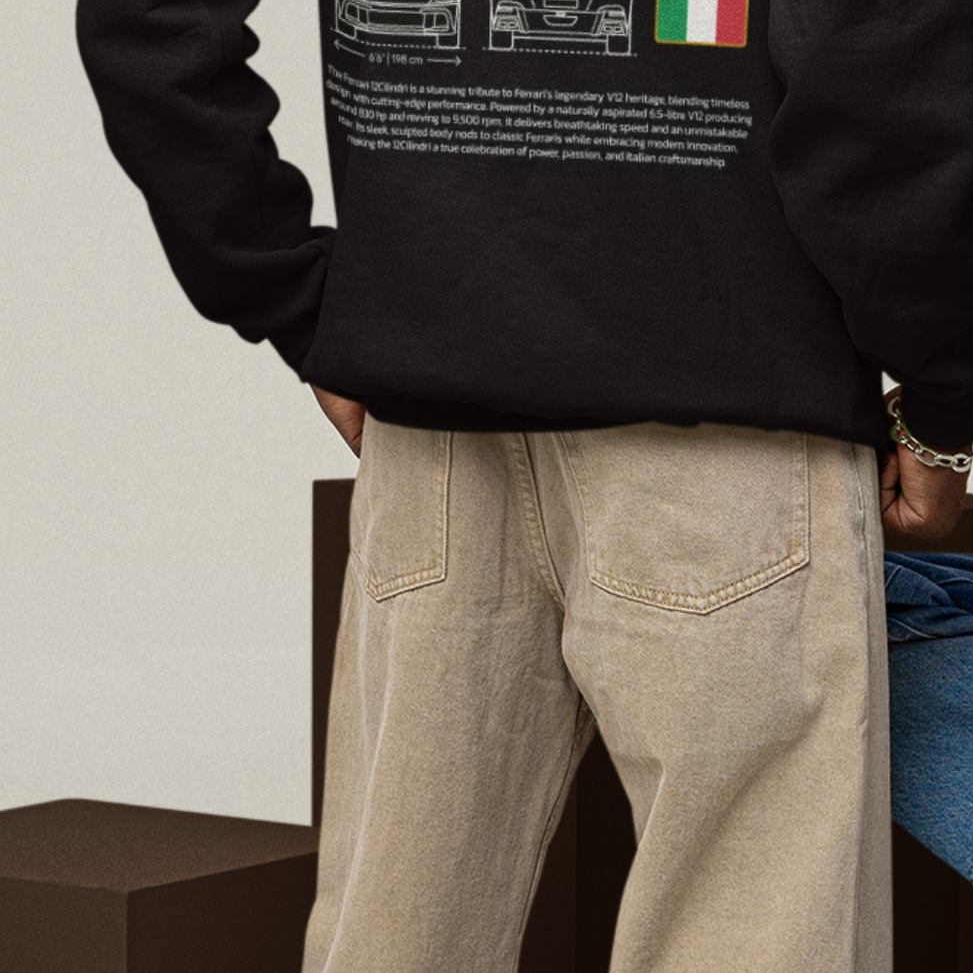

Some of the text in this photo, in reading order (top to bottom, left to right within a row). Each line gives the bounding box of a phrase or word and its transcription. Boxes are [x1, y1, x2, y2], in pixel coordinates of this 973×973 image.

[409, 56, 423, 65] cm
[410, 83, 417, 93] is
[426, 85, 466, 97] stunning
[468, 86, 500, 97] tribute
[502, 88, 512, 98] to
[554, 90, 604, 104] legendary
[607, 92, 624, 102] V12
[668, 95, 710, 109] blending
[711, 98, 750, 109] timeless
[388, 112, 405, 122] and
[441, 114, 450, 123] to
[514, 118, 552, 128] delivers
[619, 122, 649, 133] speed
[650, 124, 669, 134] and
[671, 125, 683, 134] an
[490, 101, 531, 113] Powered
[533, 103, 545, 115] by
[547, 105, 554, 113] a
[555, 105, 600, 118] naturally
[602, 107, 647, 119] aspirated
[688, 110, 704, 121] V12
[705, 112, 753, 126] producing
[391, 126, 428, 138] sculpted
[429, 128, 453, 140] body
[480, 130, 491, 140] to
[491, 131, 524, 142] classic
[563, 134, 592, 145] while
[647, 139, 686, 150] modern
[377, 139, 391, 149] the
[440, 143, 460, 153] true
[461, 145, 515, 156] celebration
[516, 146, 528, 156] of
[605, 151, 625, 161] and
